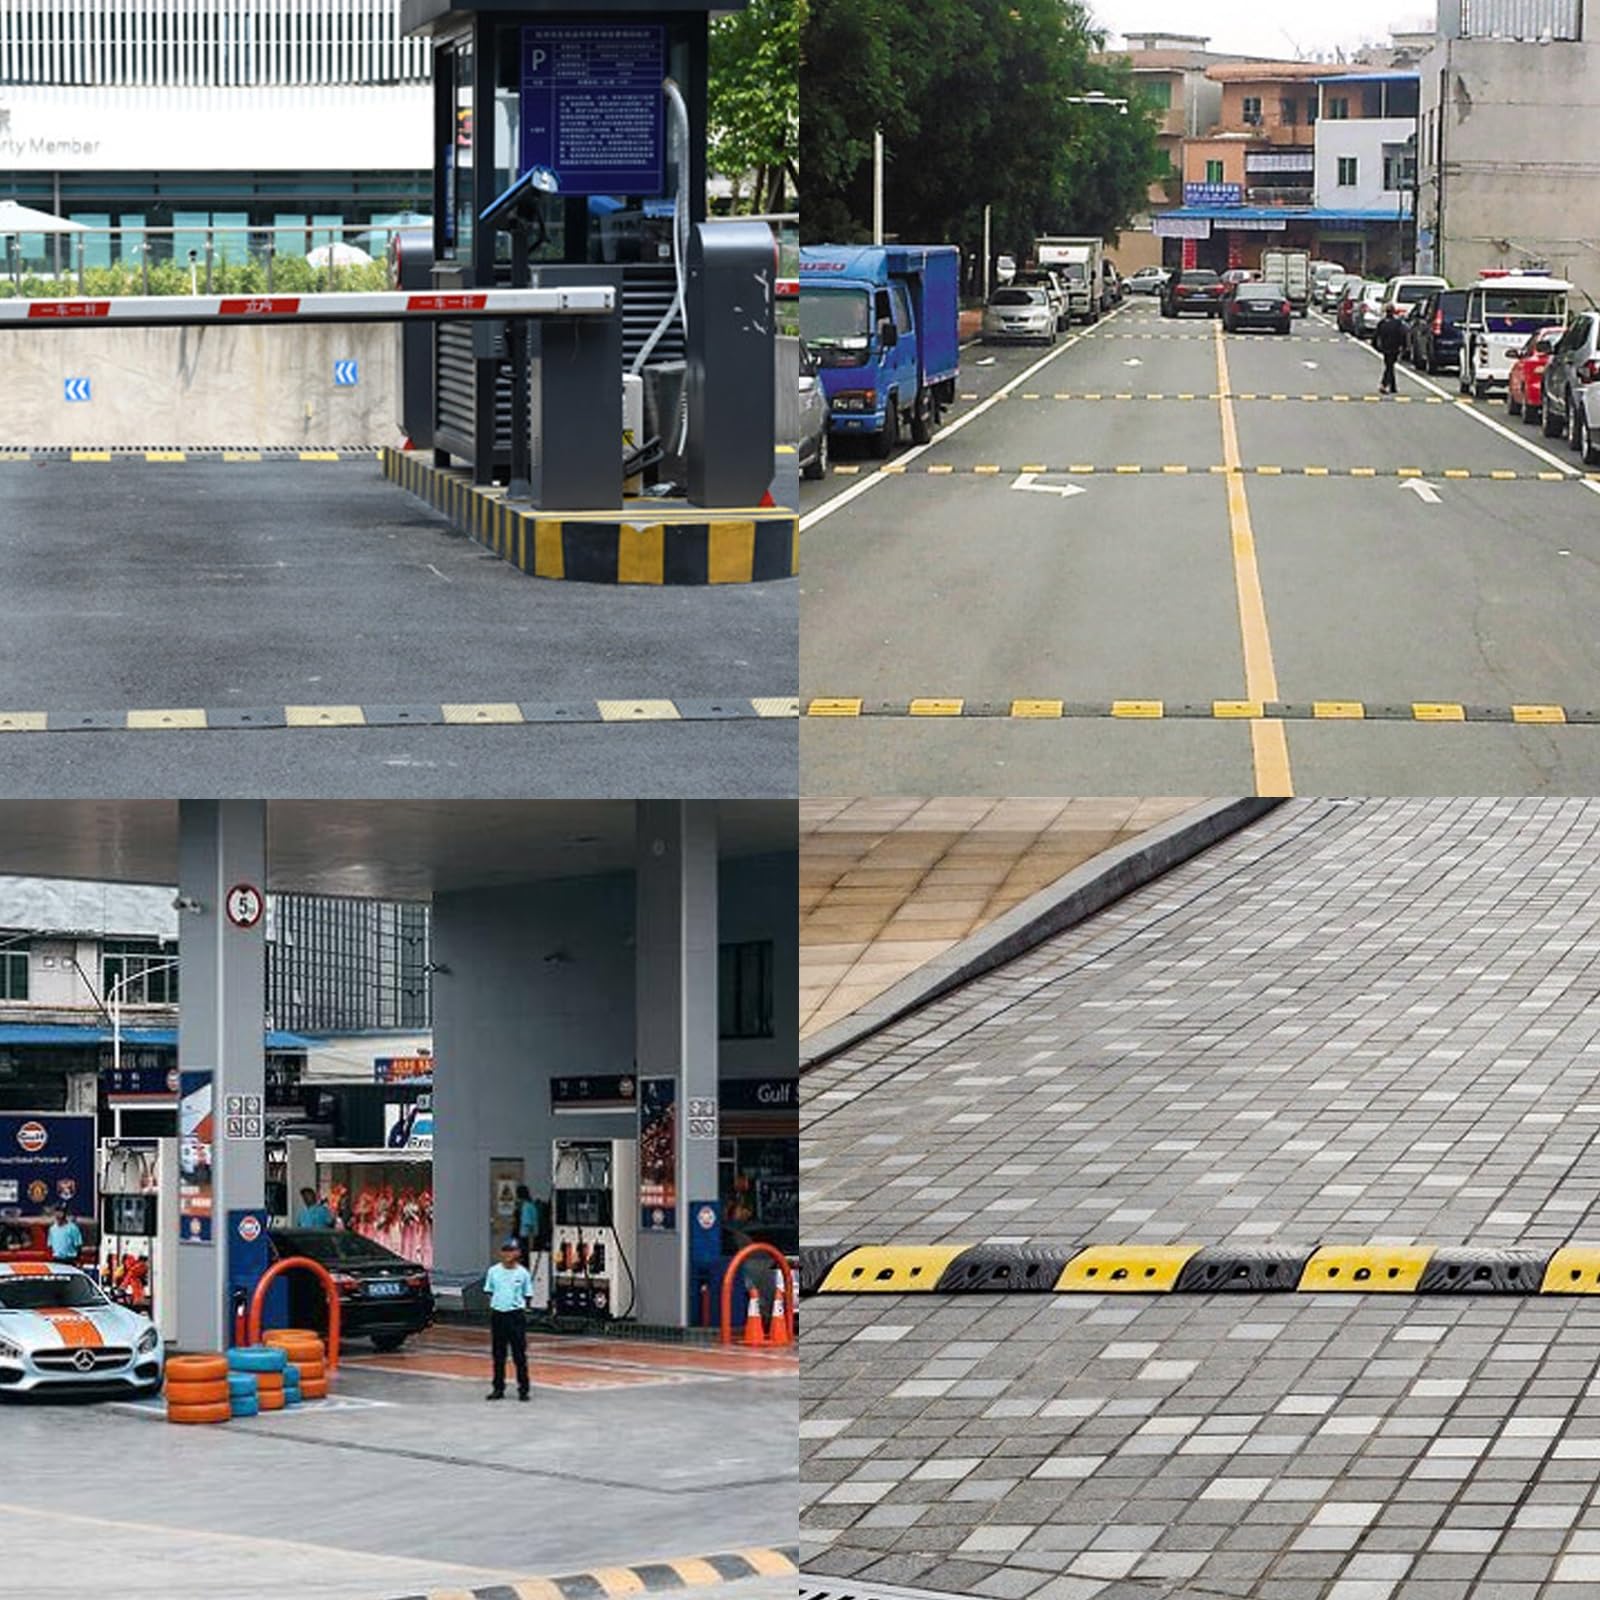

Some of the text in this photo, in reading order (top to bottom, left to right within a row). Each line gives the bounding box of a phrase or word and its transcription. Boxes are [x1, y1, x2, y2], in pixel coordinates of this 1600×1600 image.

[532, 49, 546, 71] P
[0, 136, 100, 158] rty Member
[757, 1083, 790, 1103] Gulf
